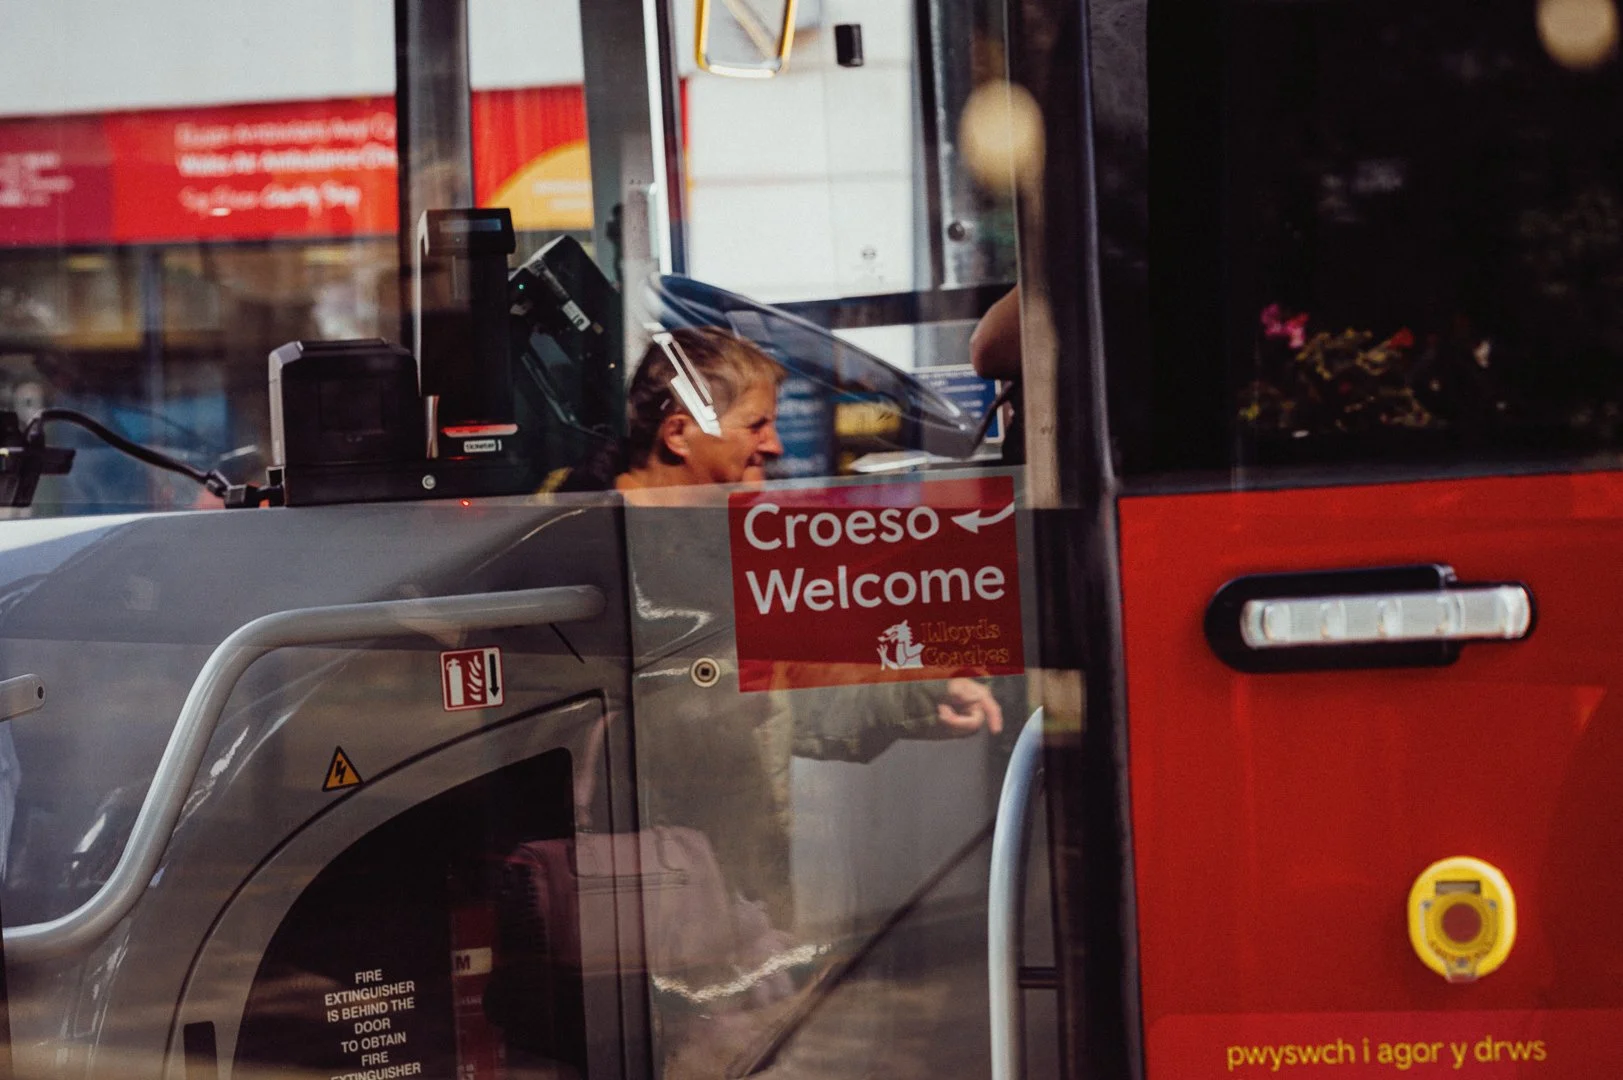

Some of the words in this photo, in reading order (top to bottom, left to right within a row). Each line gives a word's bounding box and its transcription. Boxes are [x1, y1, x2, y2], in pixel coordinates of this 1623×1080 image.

[743, 502, 940, 550] Croeso
[746, 565, 1006, 615] Welcome
[920, 617, 1001, 646] Lloyds
[924, 644, 1009, 669] Coaches
[456, 955, 470, 970] M
[354, 969, 383, 984] FIRE
[324, 981, 415, 1006] EXTINGUISHER
[327, 1010, 339, 1022] IS
[341, 1003, 388, 1020] BEHIND
[392, 997, 415, 1011] THE
[354, 1018, 391, 1034] DOOR
[341, 1040, 358, 1053] TO
[361, 1032, 406, 1050] OBTAIN
[1227, 1039, 1355, 1072] pwyswch
[1362, 1038, 1370, 1063] i
[1377, 1041, 1444, 1070] agor
[1450, 1040, 1467, 1068] y
[1474, 1034, 1547, 1062] drws
[361, 1051, 389, 1066] FIRE
